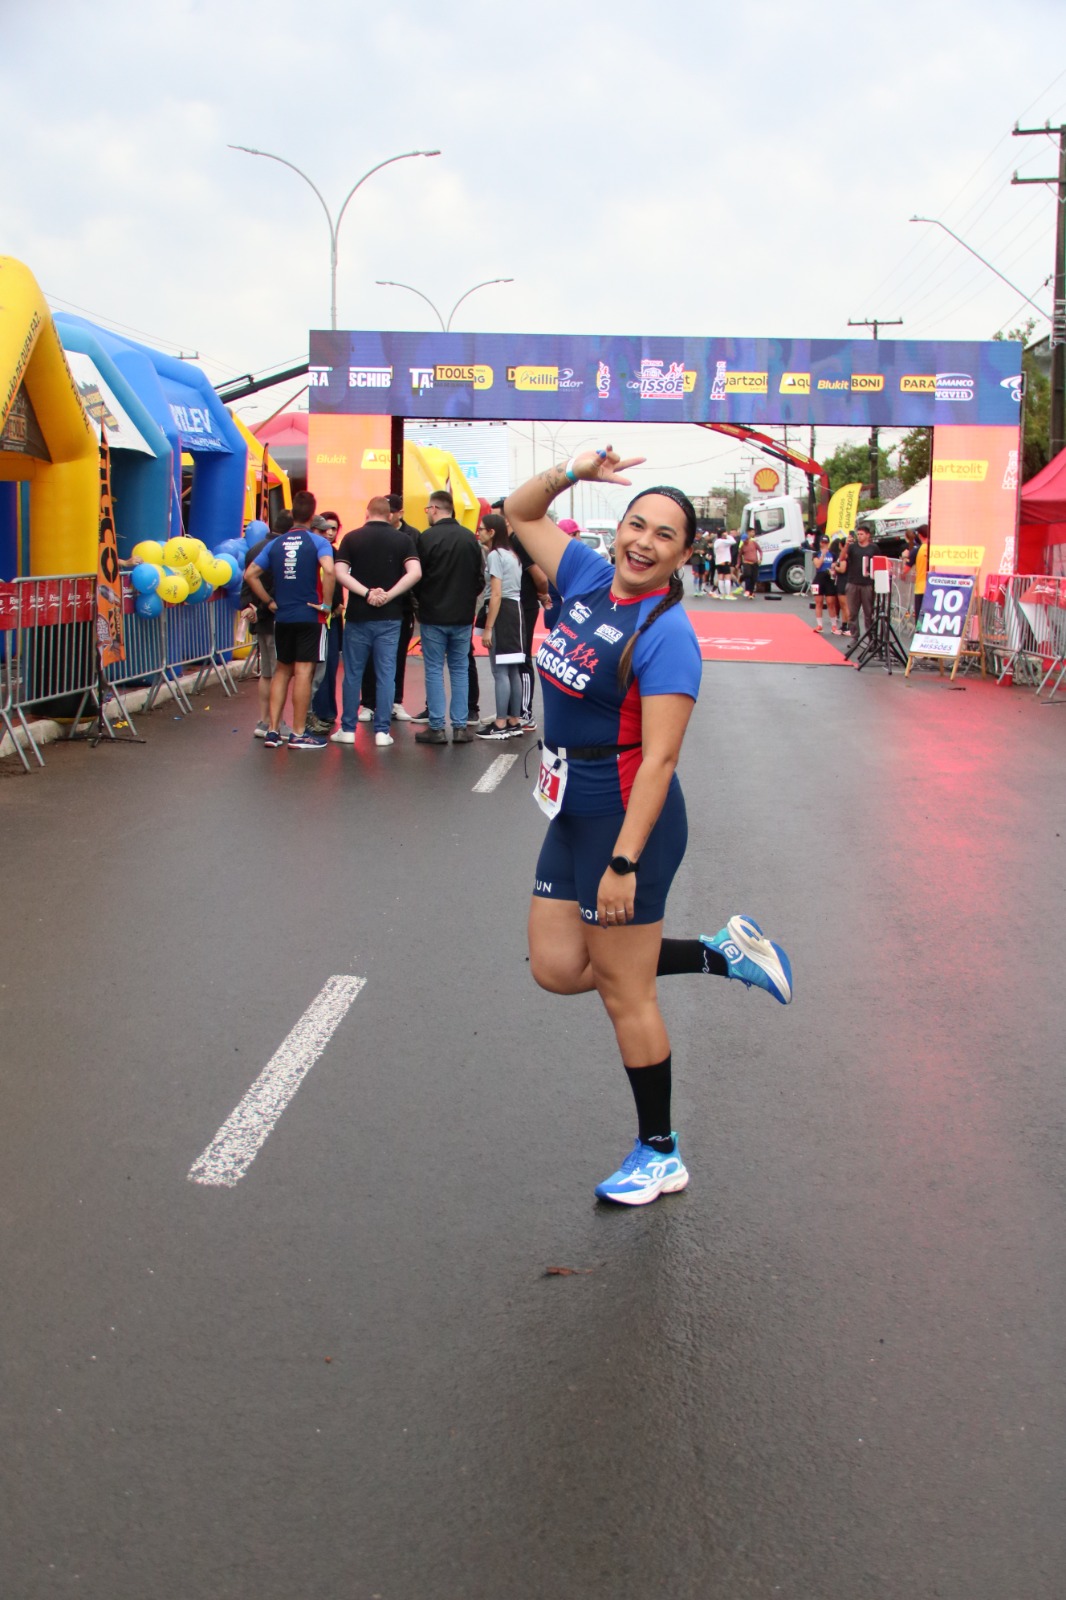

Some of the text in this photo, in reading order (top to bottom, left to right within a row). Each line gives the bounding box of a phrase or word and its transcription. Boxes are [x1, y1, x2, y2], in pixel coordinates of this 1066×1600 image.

[438, 367, 474, 379] TOOLS
[817, 379, 849, 390] Blukit
[852, 378, 880, 388] BONI
[903, 379, 935, 389] PARA
[936, 379, 974, 387] AMANCO
[316, 454, 347, 464] Blukit
[844, 490, 855, 529] quartzolit
[932, 588, 964, 613] 10
[921, 612, 962, 636] KM
[919, 642, 952, 651] MISSÕES
